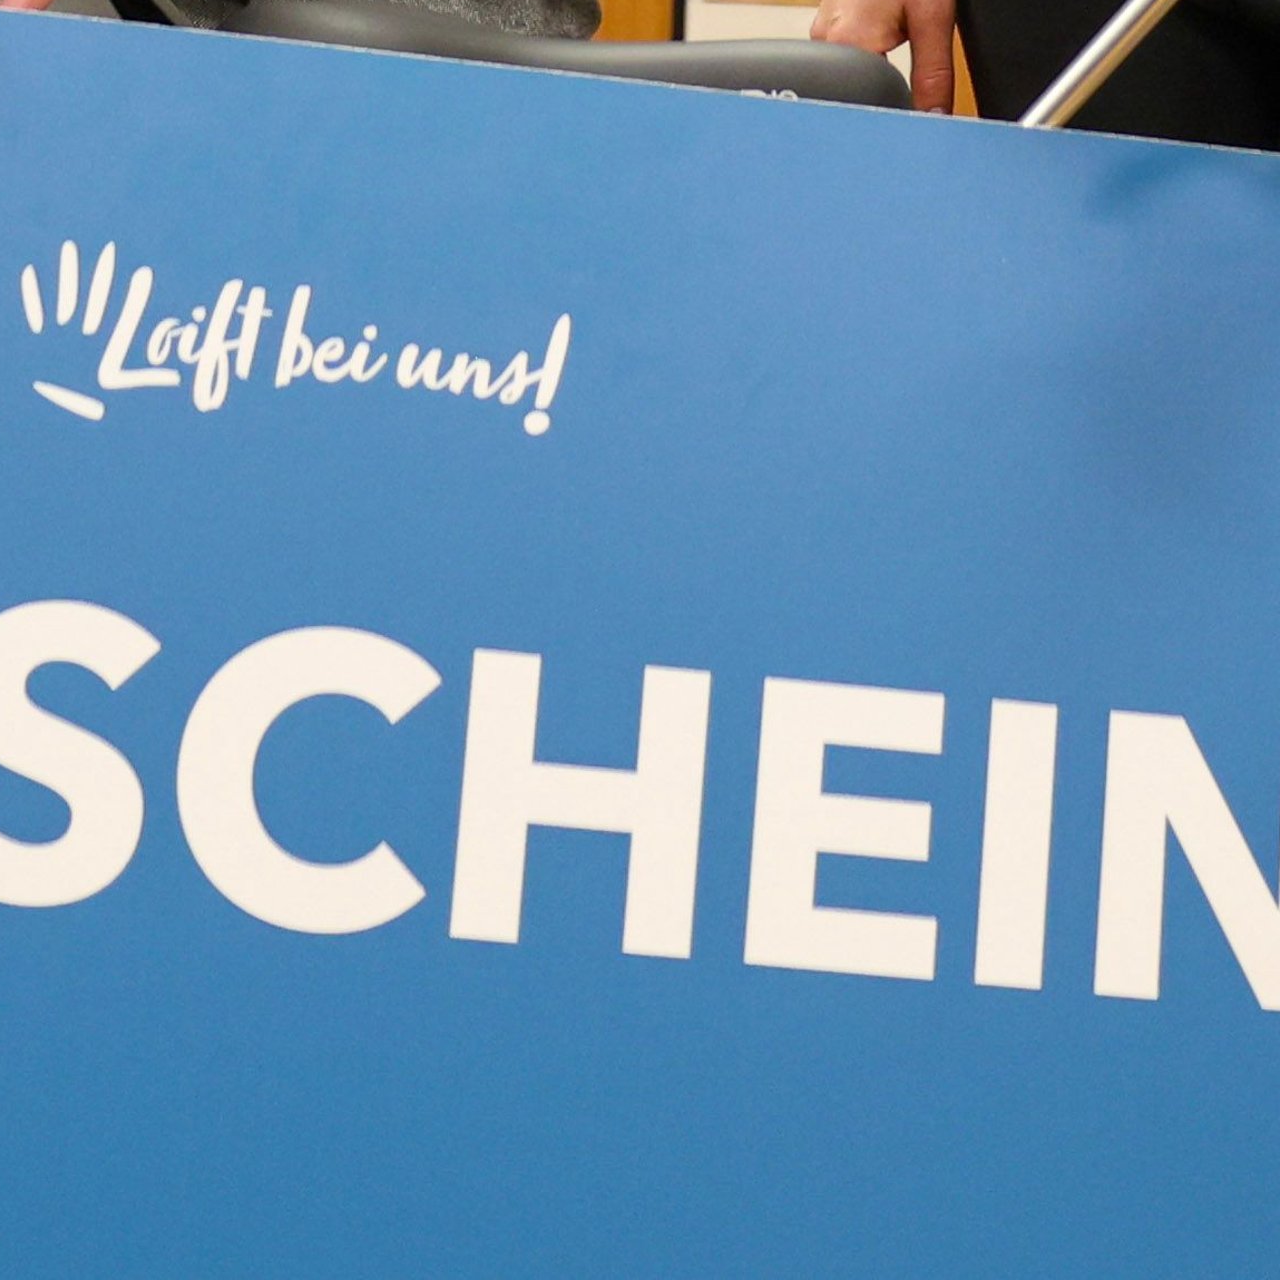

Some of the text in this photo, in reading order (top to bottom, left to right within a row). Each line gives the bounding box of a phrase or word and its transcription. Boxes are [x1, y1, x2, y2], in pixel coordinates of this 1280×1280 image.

[97, 264, 572, 437] Laift bei uns!
